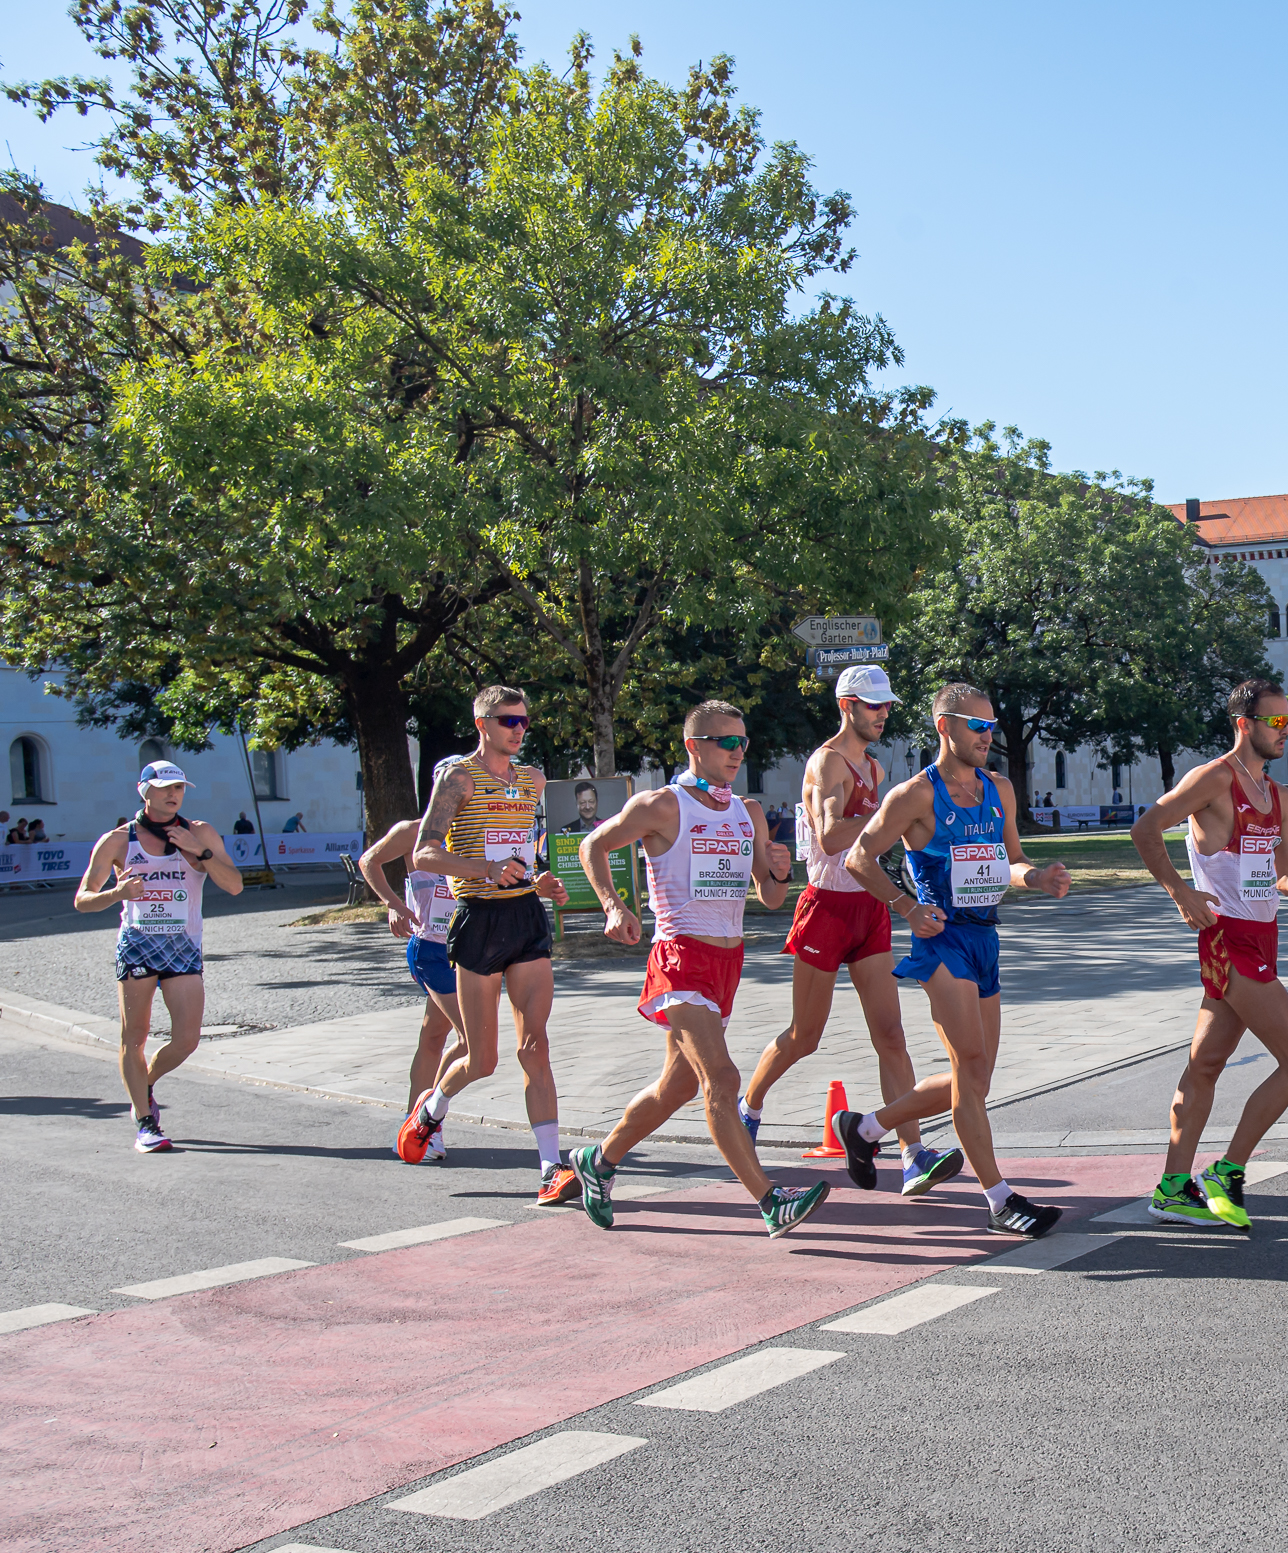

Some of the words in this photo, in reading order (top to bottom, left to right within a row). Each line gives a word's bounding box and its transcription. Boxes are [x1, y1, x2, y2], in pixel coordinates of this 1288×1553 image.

[810, 619, 861, 632] Englischer
[820, 632, 853, 643] Garten
[964, 821, 996, 837] ITALIA
[555, 838, 576, 846] SIND
[693, 840, 739, 853] SPAR
[1244, 840, 1273, 852] SPA
[288, 846, 315, 855] Sparkasse
[325, 843, 349, 852] Allianz
[557, 846, 579, 854] GERET
[37, 850, 64, 860] TOYO
[953, 847, 995, 860] SPAR
[41, 861, 70, 871] TIRES
[608, 858, 626, 866] RNEIS
[718, 859, 731, 871] 50
[699, 871, 744, 879] BRZOZOWSKI
[977, 865, 990, 876] 41
[963, 877, 1002, 885] ANTONELLI
[131, 890, 172, 900] PAR
[694, 889, 727, 898] MUNICH
[729, 889, 746, 898] 2022
[956, 895, 989, 905] MUNICH
[991, 894, 1003, 903] 202
[150, 903, 165, 913] 25
[432, 923, 451, 932] MUN
